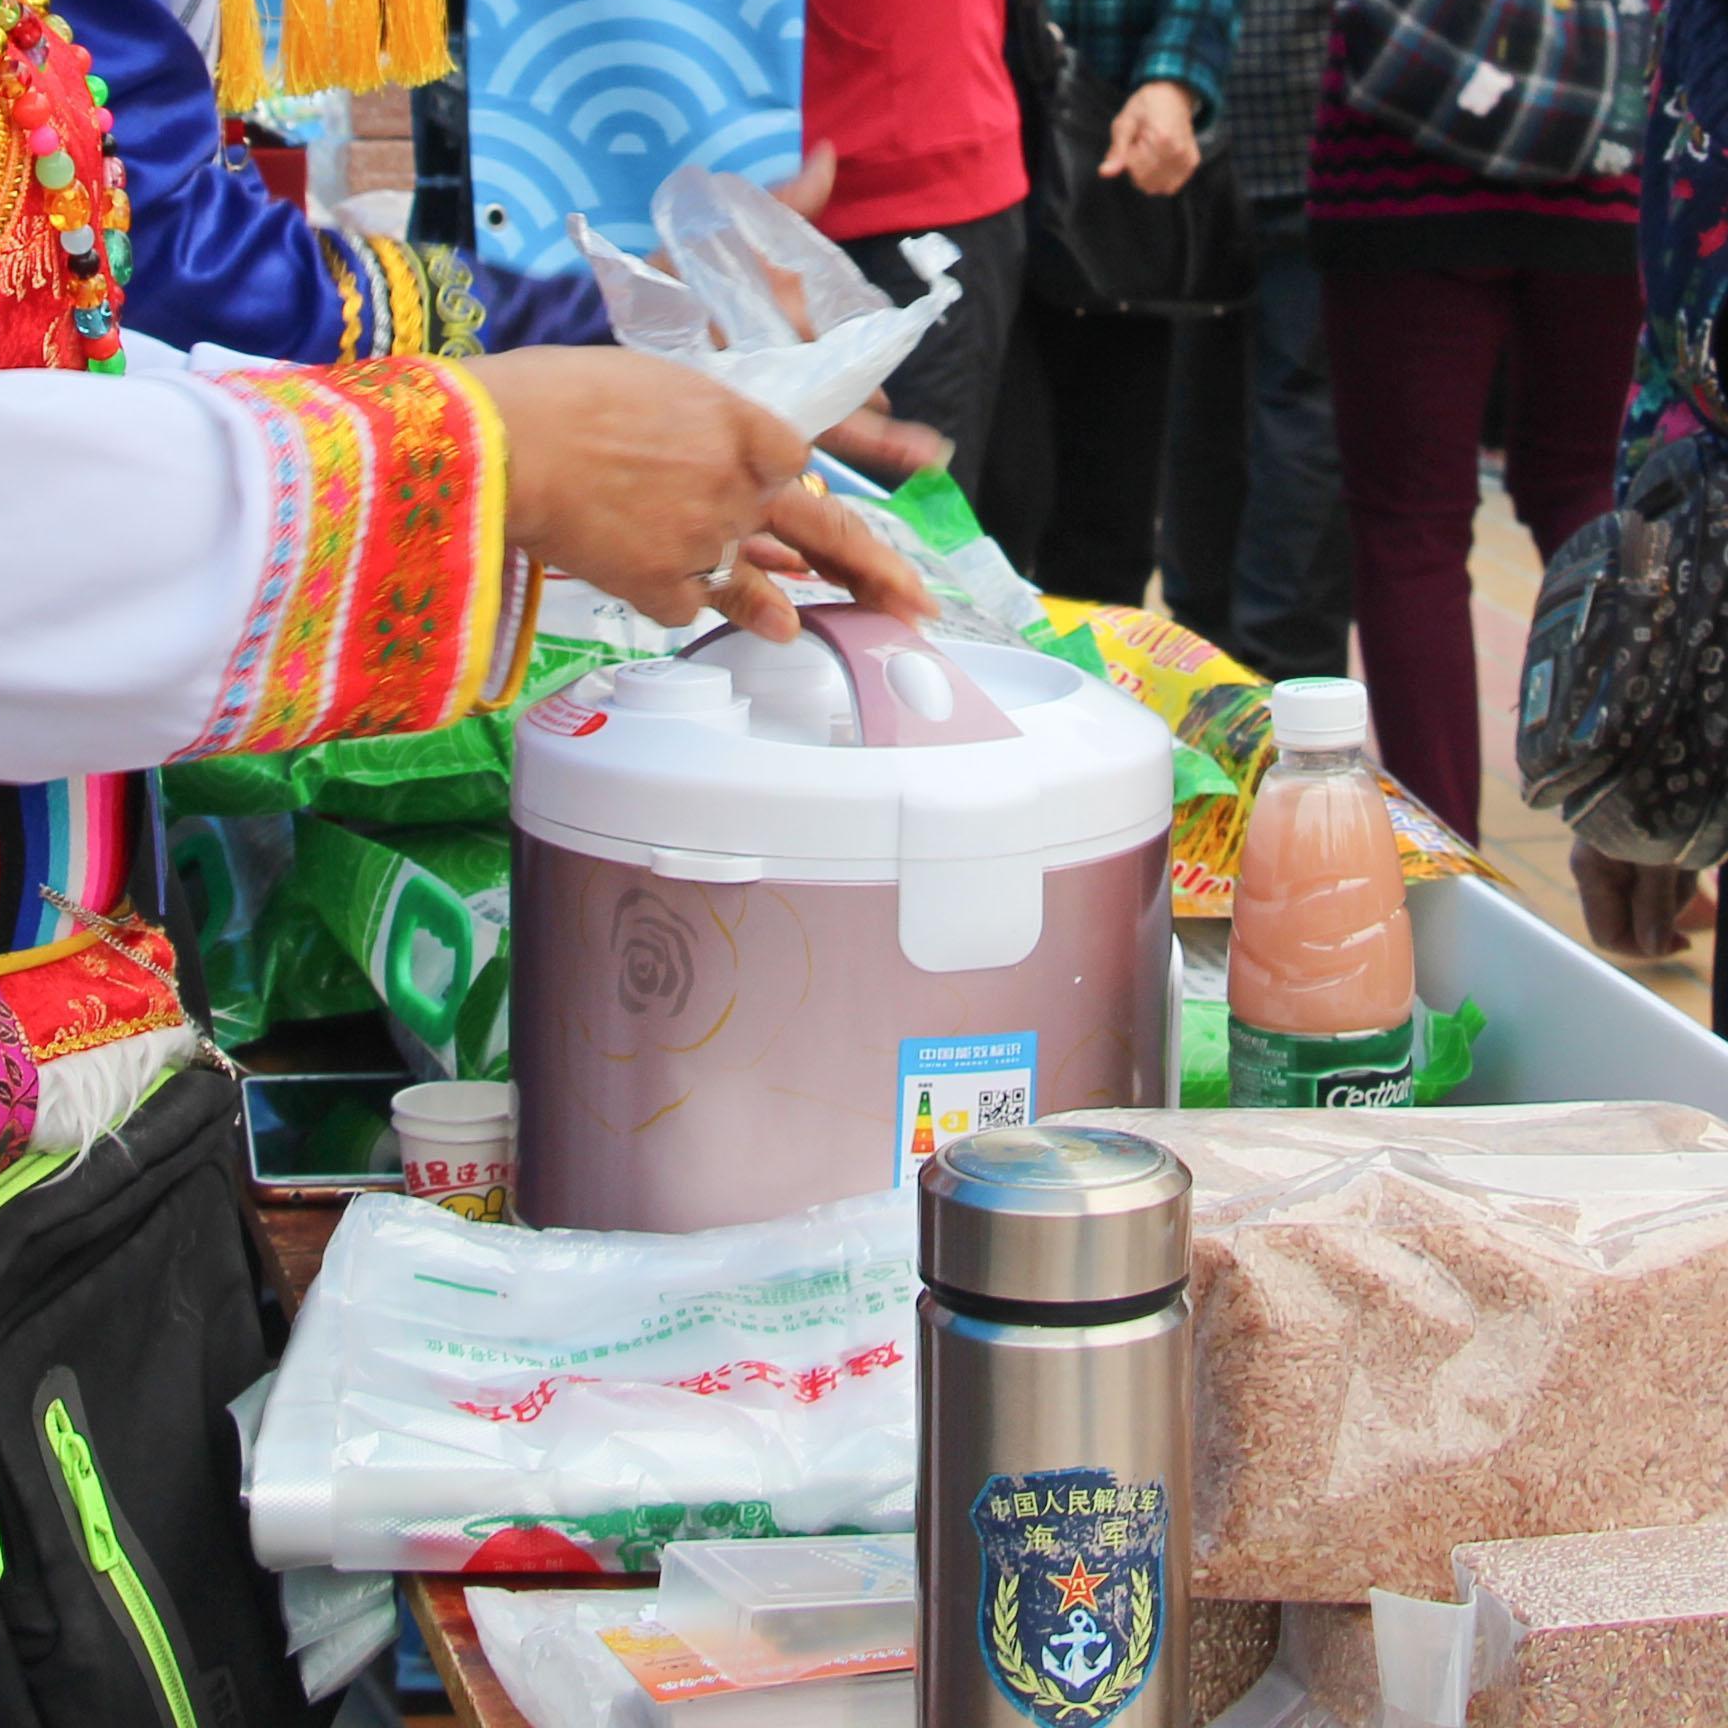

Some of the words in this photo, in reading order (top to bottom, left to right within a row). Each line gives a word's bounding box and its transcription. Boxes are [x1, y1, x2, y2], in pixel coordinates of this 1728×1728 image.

[918, 1042, 1021, 1061] 中国能效标识
[989, 1487, 1158, 1521] 中国人民解放军
[1022, 1523, 1059, 1556] 海
[1100, 1518, 1129, 1550] 军
